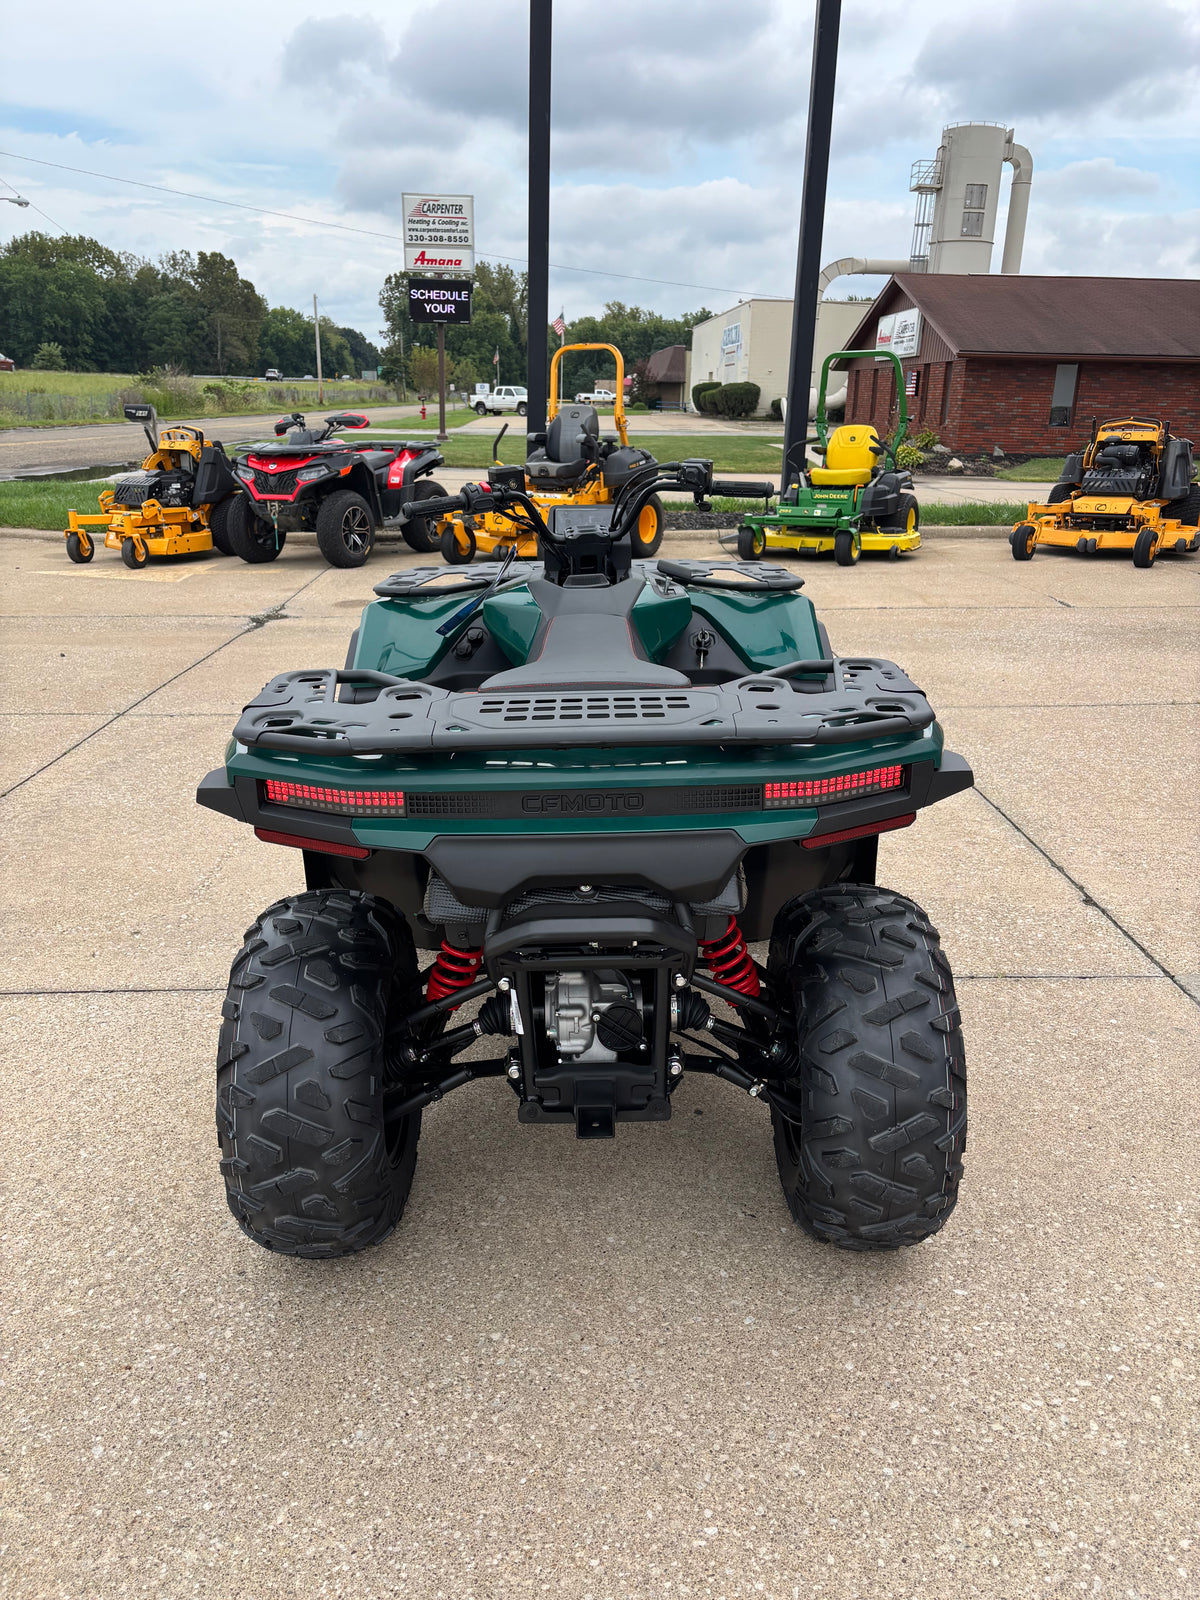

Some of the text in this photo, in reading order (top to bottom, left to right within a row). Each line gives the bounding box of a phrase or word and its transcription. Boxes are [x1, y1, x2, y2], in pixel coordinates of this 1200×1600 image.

[421, 203, 464, 214] CARPENTER
[408, 218, 430, 227] Heating
[438, 219, 459, 227] Cooling
[413, 250, 462, 266] Amana
[410, 289, 469, 301] SCHEDULE
[424, 303, 455, 313] YOUR
[521, 793, 645, 813] CFMOTO
